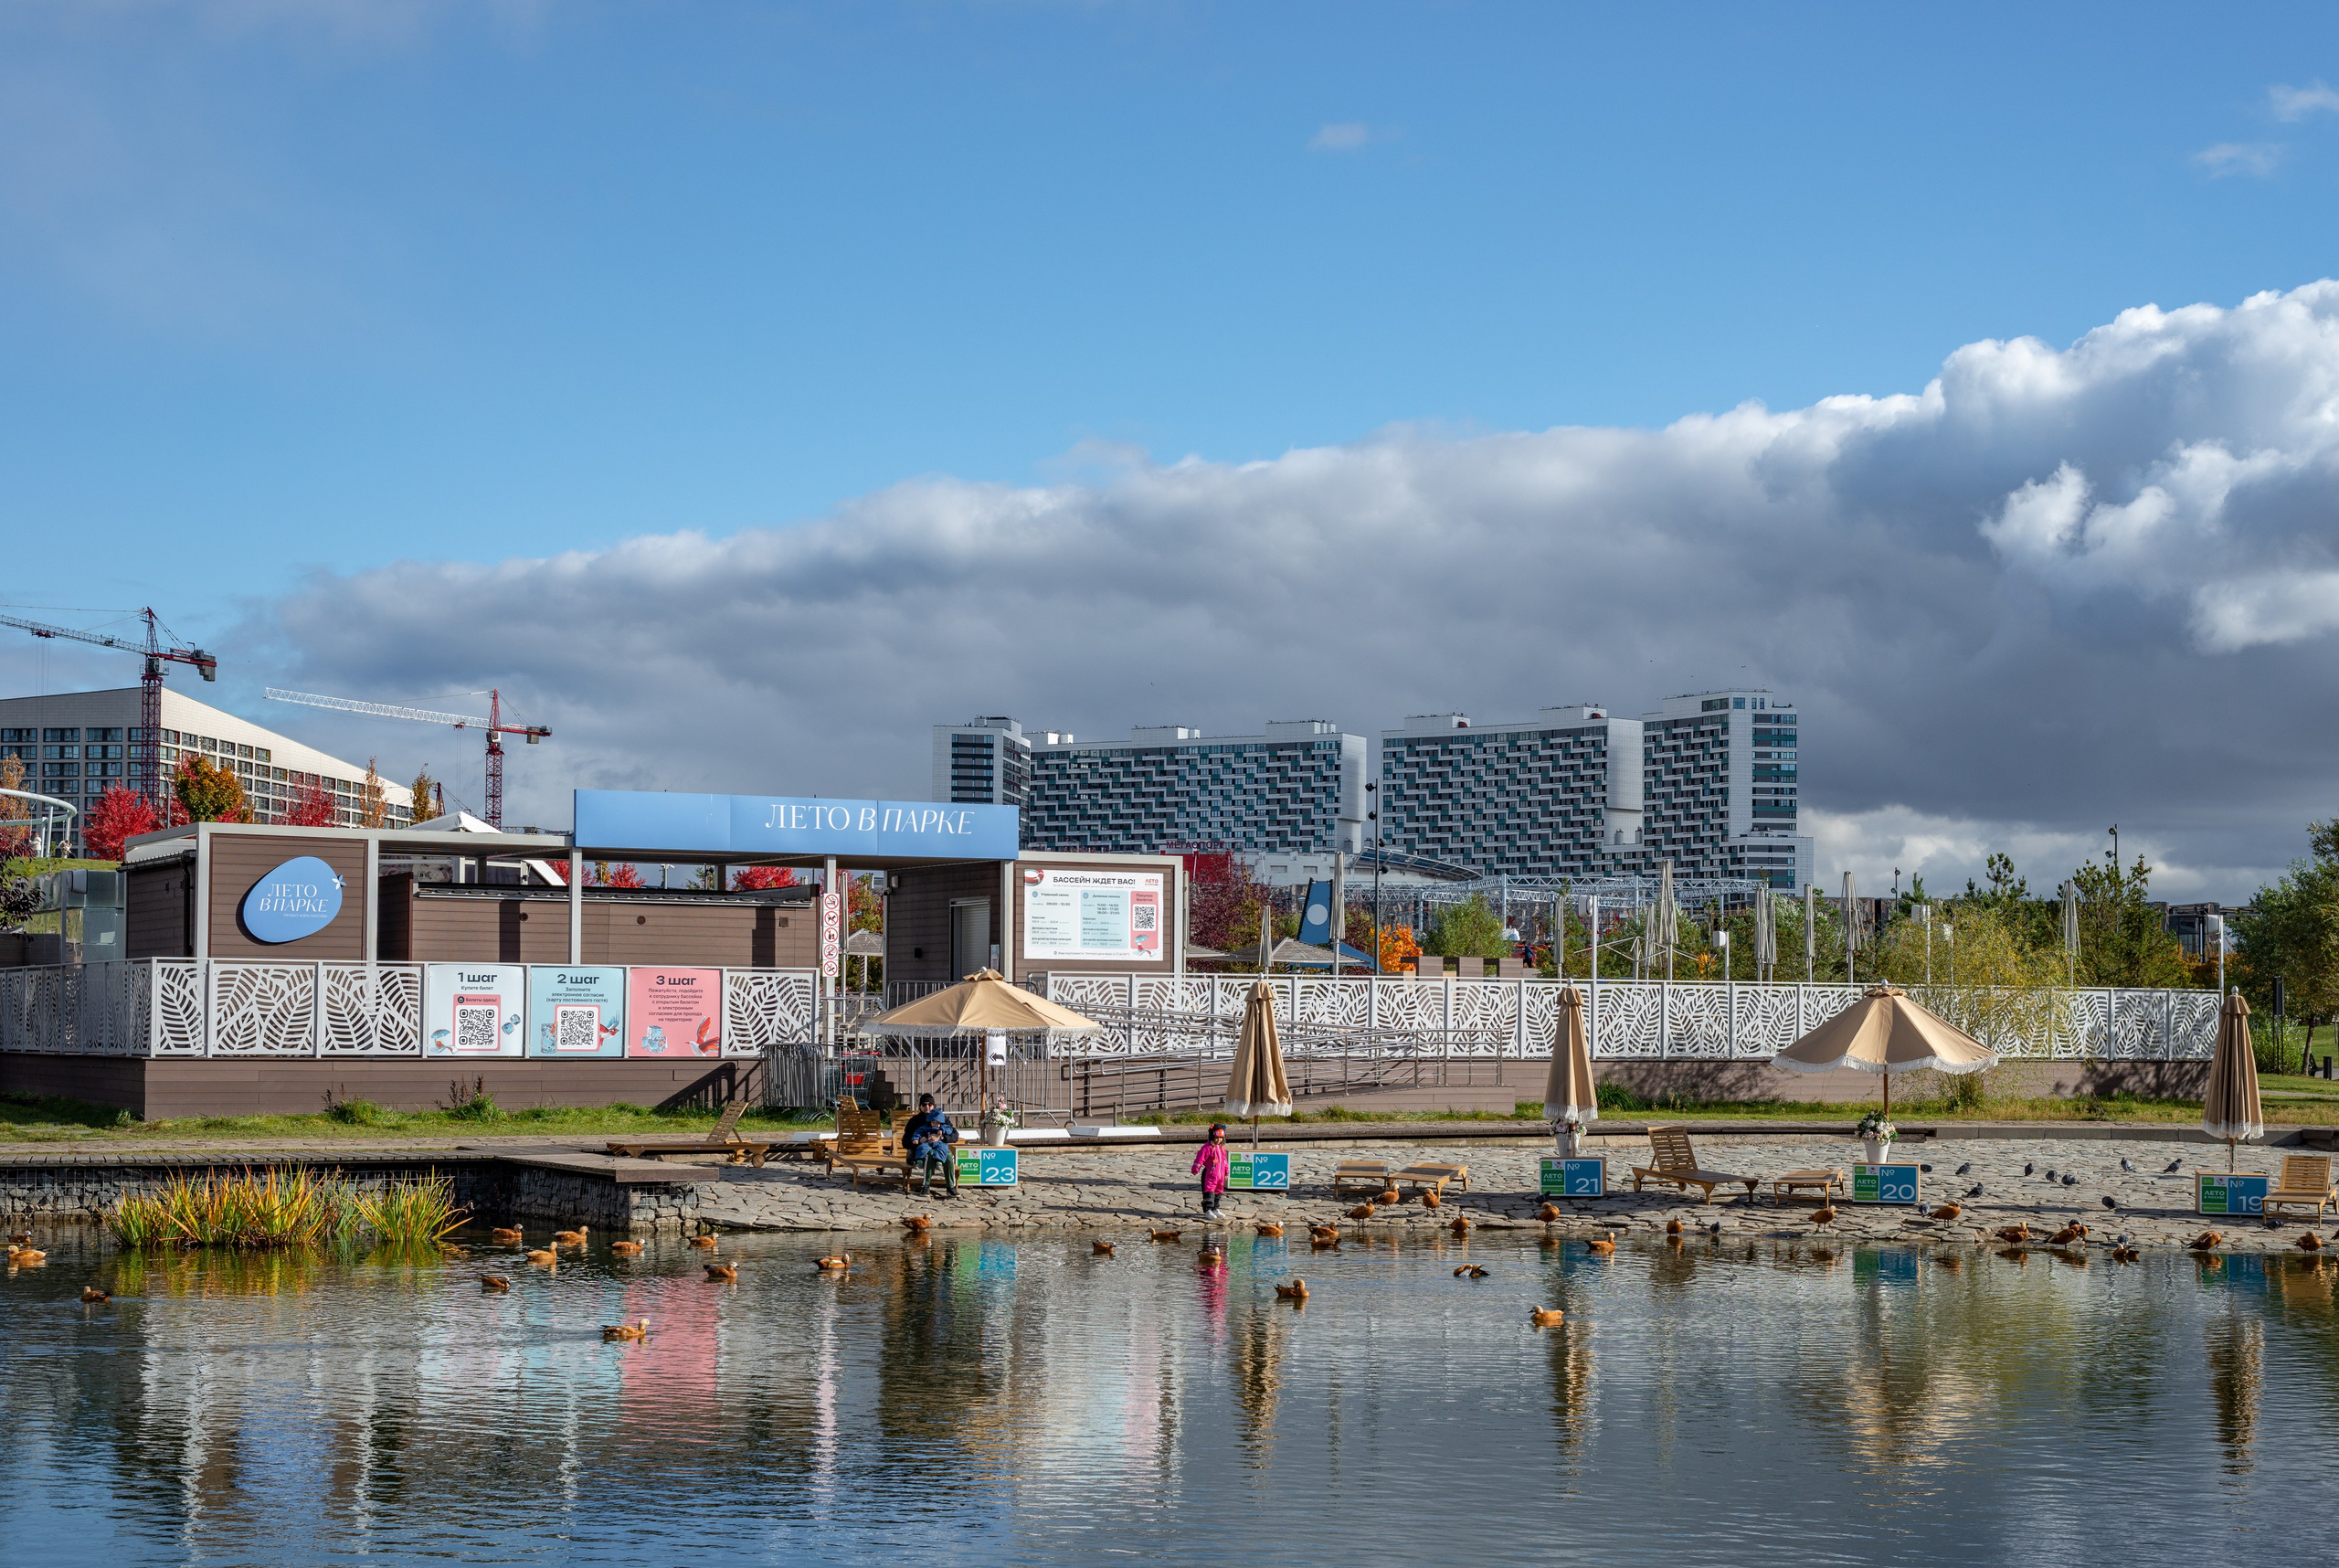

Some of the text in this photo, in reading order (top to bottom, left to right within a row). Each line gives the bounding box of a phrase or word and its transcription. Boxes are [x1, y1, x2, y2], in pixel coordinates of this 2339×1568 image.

[765, 804, 975, 834] ЛЕТО В ПАРКЕ
[268, 884, 317, 897] ЛЕТО
[259, 897, 329, 912] В ПАРКЕ
[457, 972, 497, 982] 1 шаг
[556, 973, 599, 984] 2 шаг
[656, 975, 665, 985] 3
[985, 1167, 1014, 1181] 23
[1257, 1171, 1286, 1186] 22
[1575, 1177, 1598, 1192] 21
[1882, 1183, 1915, 1200] 20
[2238, 1195, 2263, 1212] 19
